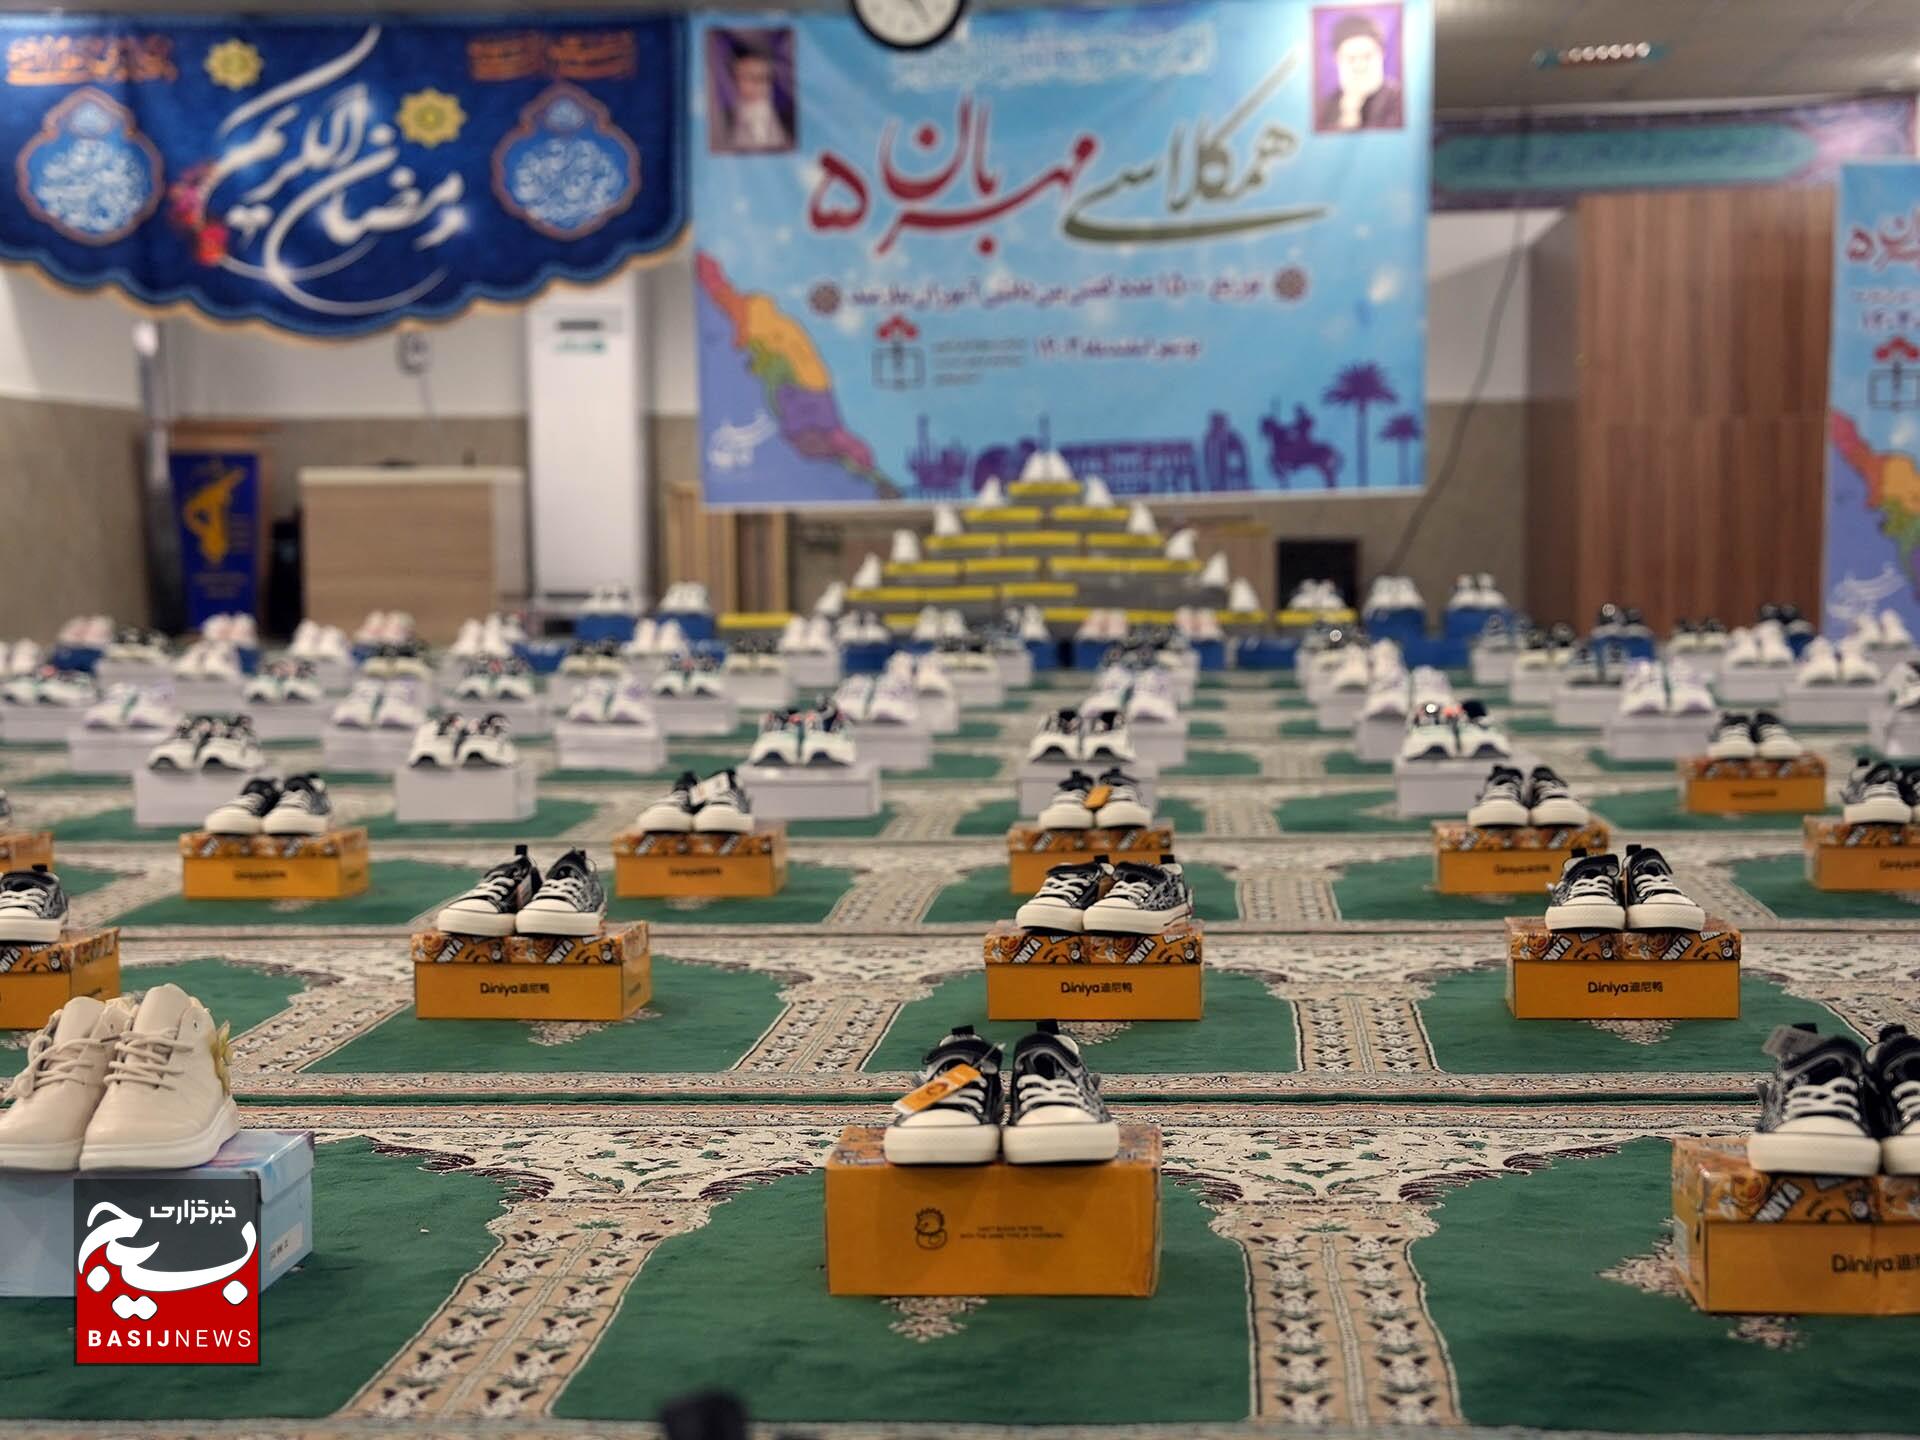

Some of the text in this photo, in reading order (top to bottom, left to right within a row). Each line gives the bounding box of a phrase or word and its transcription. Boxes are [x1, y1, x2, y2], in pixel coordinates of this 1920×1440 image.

[1060, 50, 1330, 245] همکلاسی
[876, 92, 1098, 256] مهربان
[808, 150, 870, 233] ۵
[480, 983, 518, 997] Diniya
[1061, 982, 1099, 996] Diniya
[1588, 982, 1628, 996] Diniya
[1832, 1254, 1893, 1279] Diniya
